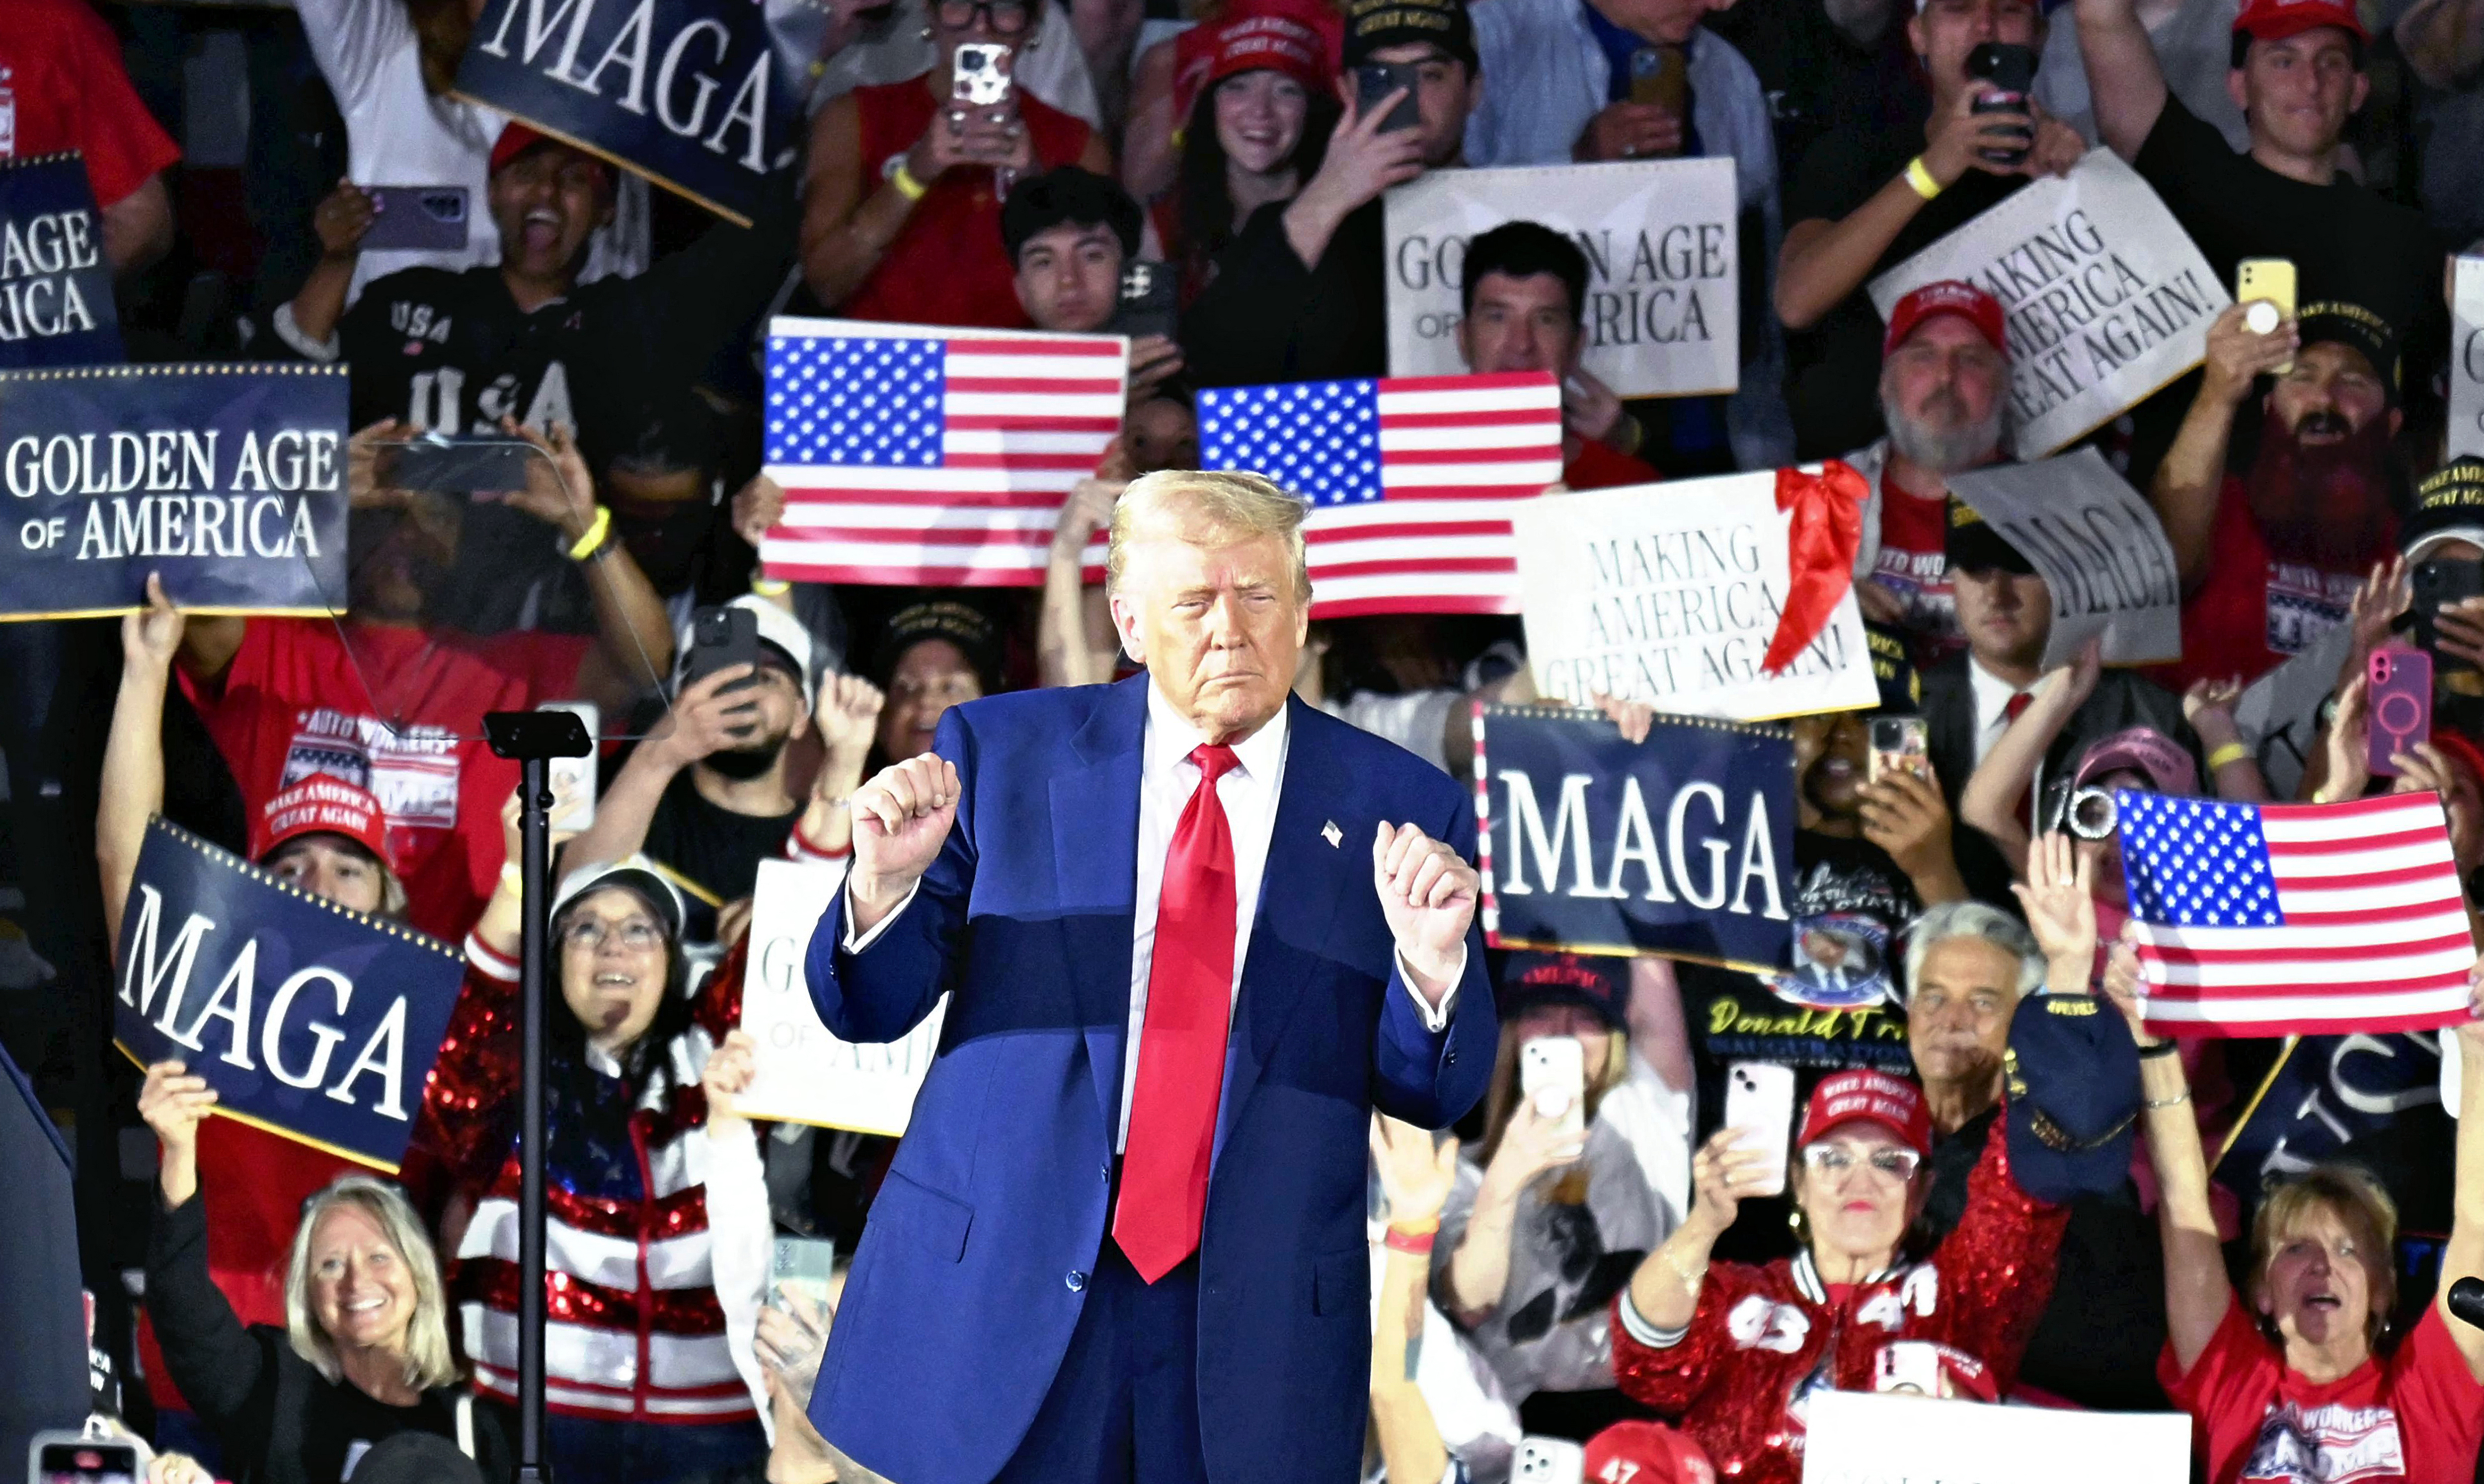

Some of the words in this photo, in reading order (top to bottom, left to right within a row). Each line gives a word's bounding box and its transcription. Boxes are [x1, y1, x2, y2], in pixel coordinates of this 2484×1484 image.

[480, 0, 771, 174] MAGA
[1, 211, 98, 279] AGE
[1396, 228, 1613, 292] GON
[1630, 223, 1727, 285] AGE
[1966, 208, 2105, 304] AKING
[390, 300, 453, 345] USA
[1416, 312, 1458, 341] OF
[1593, 289, 1712, 348] RICA
[2004, 252, 2149, 366] MERICA
[2012, 344, 2086, 424] EAT
[2088, 268, 2216, 381] AGAIN!
[5, 429, 220, 498] GOLDEN
[230, 429, 340, 492] AGE
[20, 517, 67, 550] OF
[76, 495, 321, 560] AMERICA
[1590, 523, 1761, 592] MAKING
[1587, 579, 1782, 650] AMERICA
[1546, 647, 1681, 708] GREAT
[306, 708, 355, 739] AUTO
[271, 804, 317, 835] GREAT
[319, 806, 368, 833] AGAIN
[306, 782, 376, 816] AMERICA
[1498, 770, 1790, 920] MAGA
[118, 883, 409, 1121] MAGA
[1709, 999, 1843, 1039] Donald
[1599, 1458, 1642, 1484] 47
